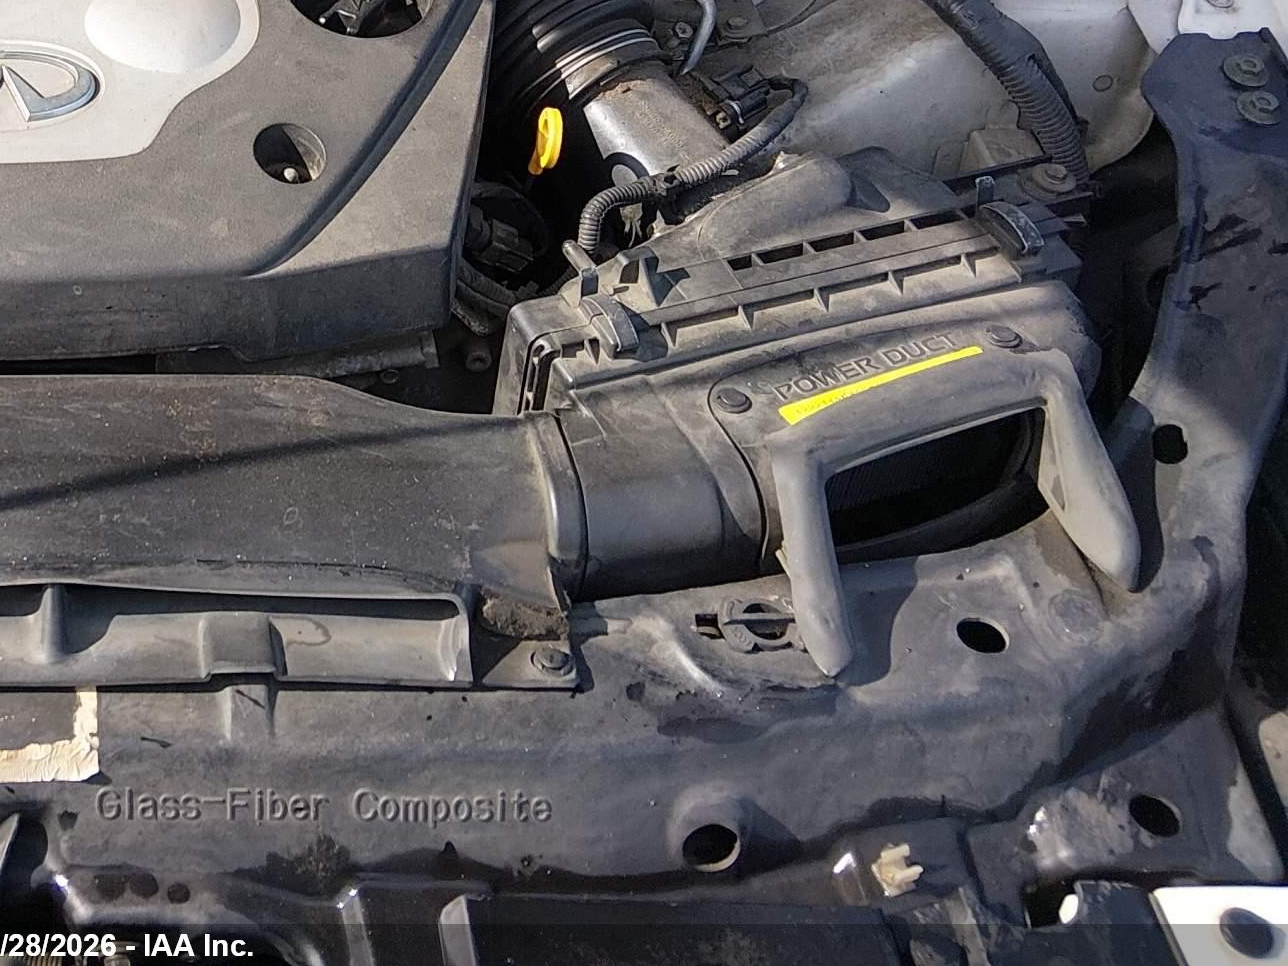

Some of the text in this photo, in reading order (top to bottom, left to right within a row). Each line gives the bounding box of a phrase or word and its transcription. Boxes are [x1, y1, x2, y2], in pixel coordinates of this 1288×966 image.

[772, 331, 959, 402] POWER DUCT
[95, 786, 553, 828] Glass-Fiber Composite
